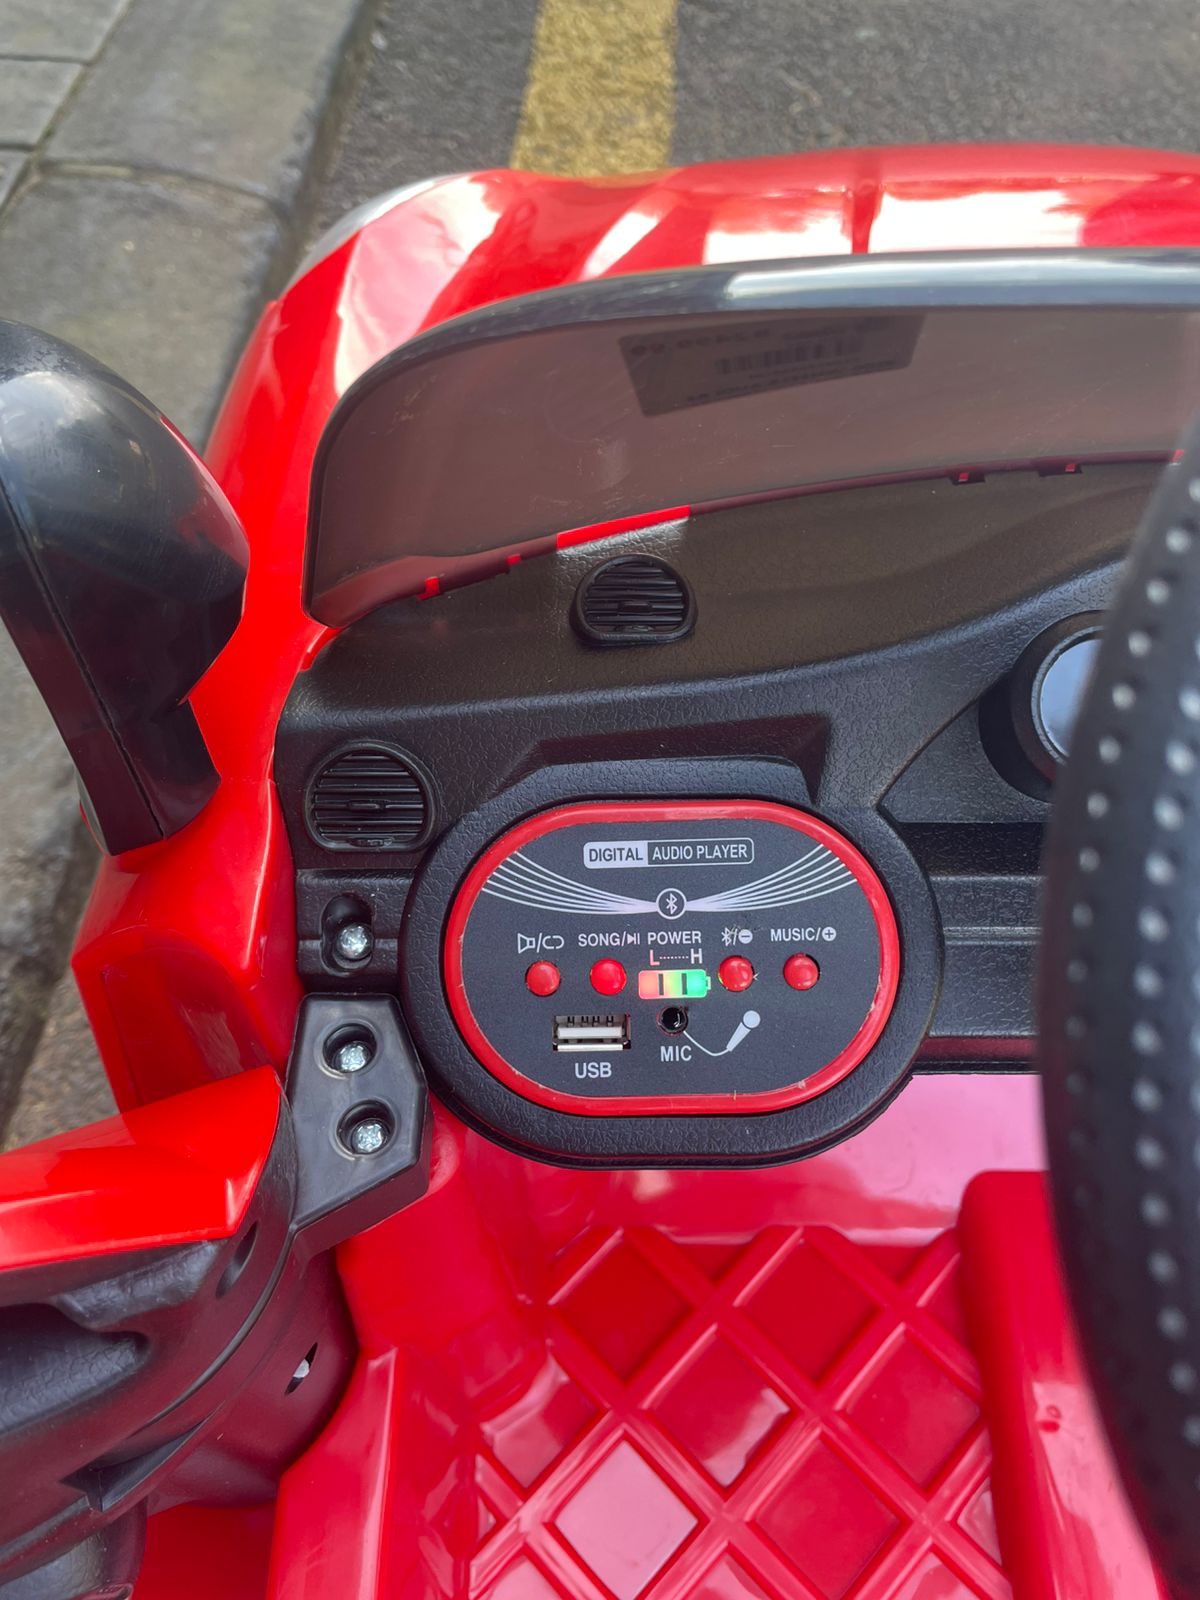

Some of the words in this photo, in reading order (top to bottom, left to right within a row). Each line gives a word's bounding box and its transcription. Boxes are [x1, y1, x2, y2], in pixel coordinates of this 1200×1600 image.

[588, 847, 644, 862] DIGITAL
[652, 845, 693, 861] AUDIO
[696, 843, 748, 860] PLAYER
[647, 930, 702, 945] POWER
[660, 1045, 692, 1062] MIC
[574, 1061, 612, 1079] USB
